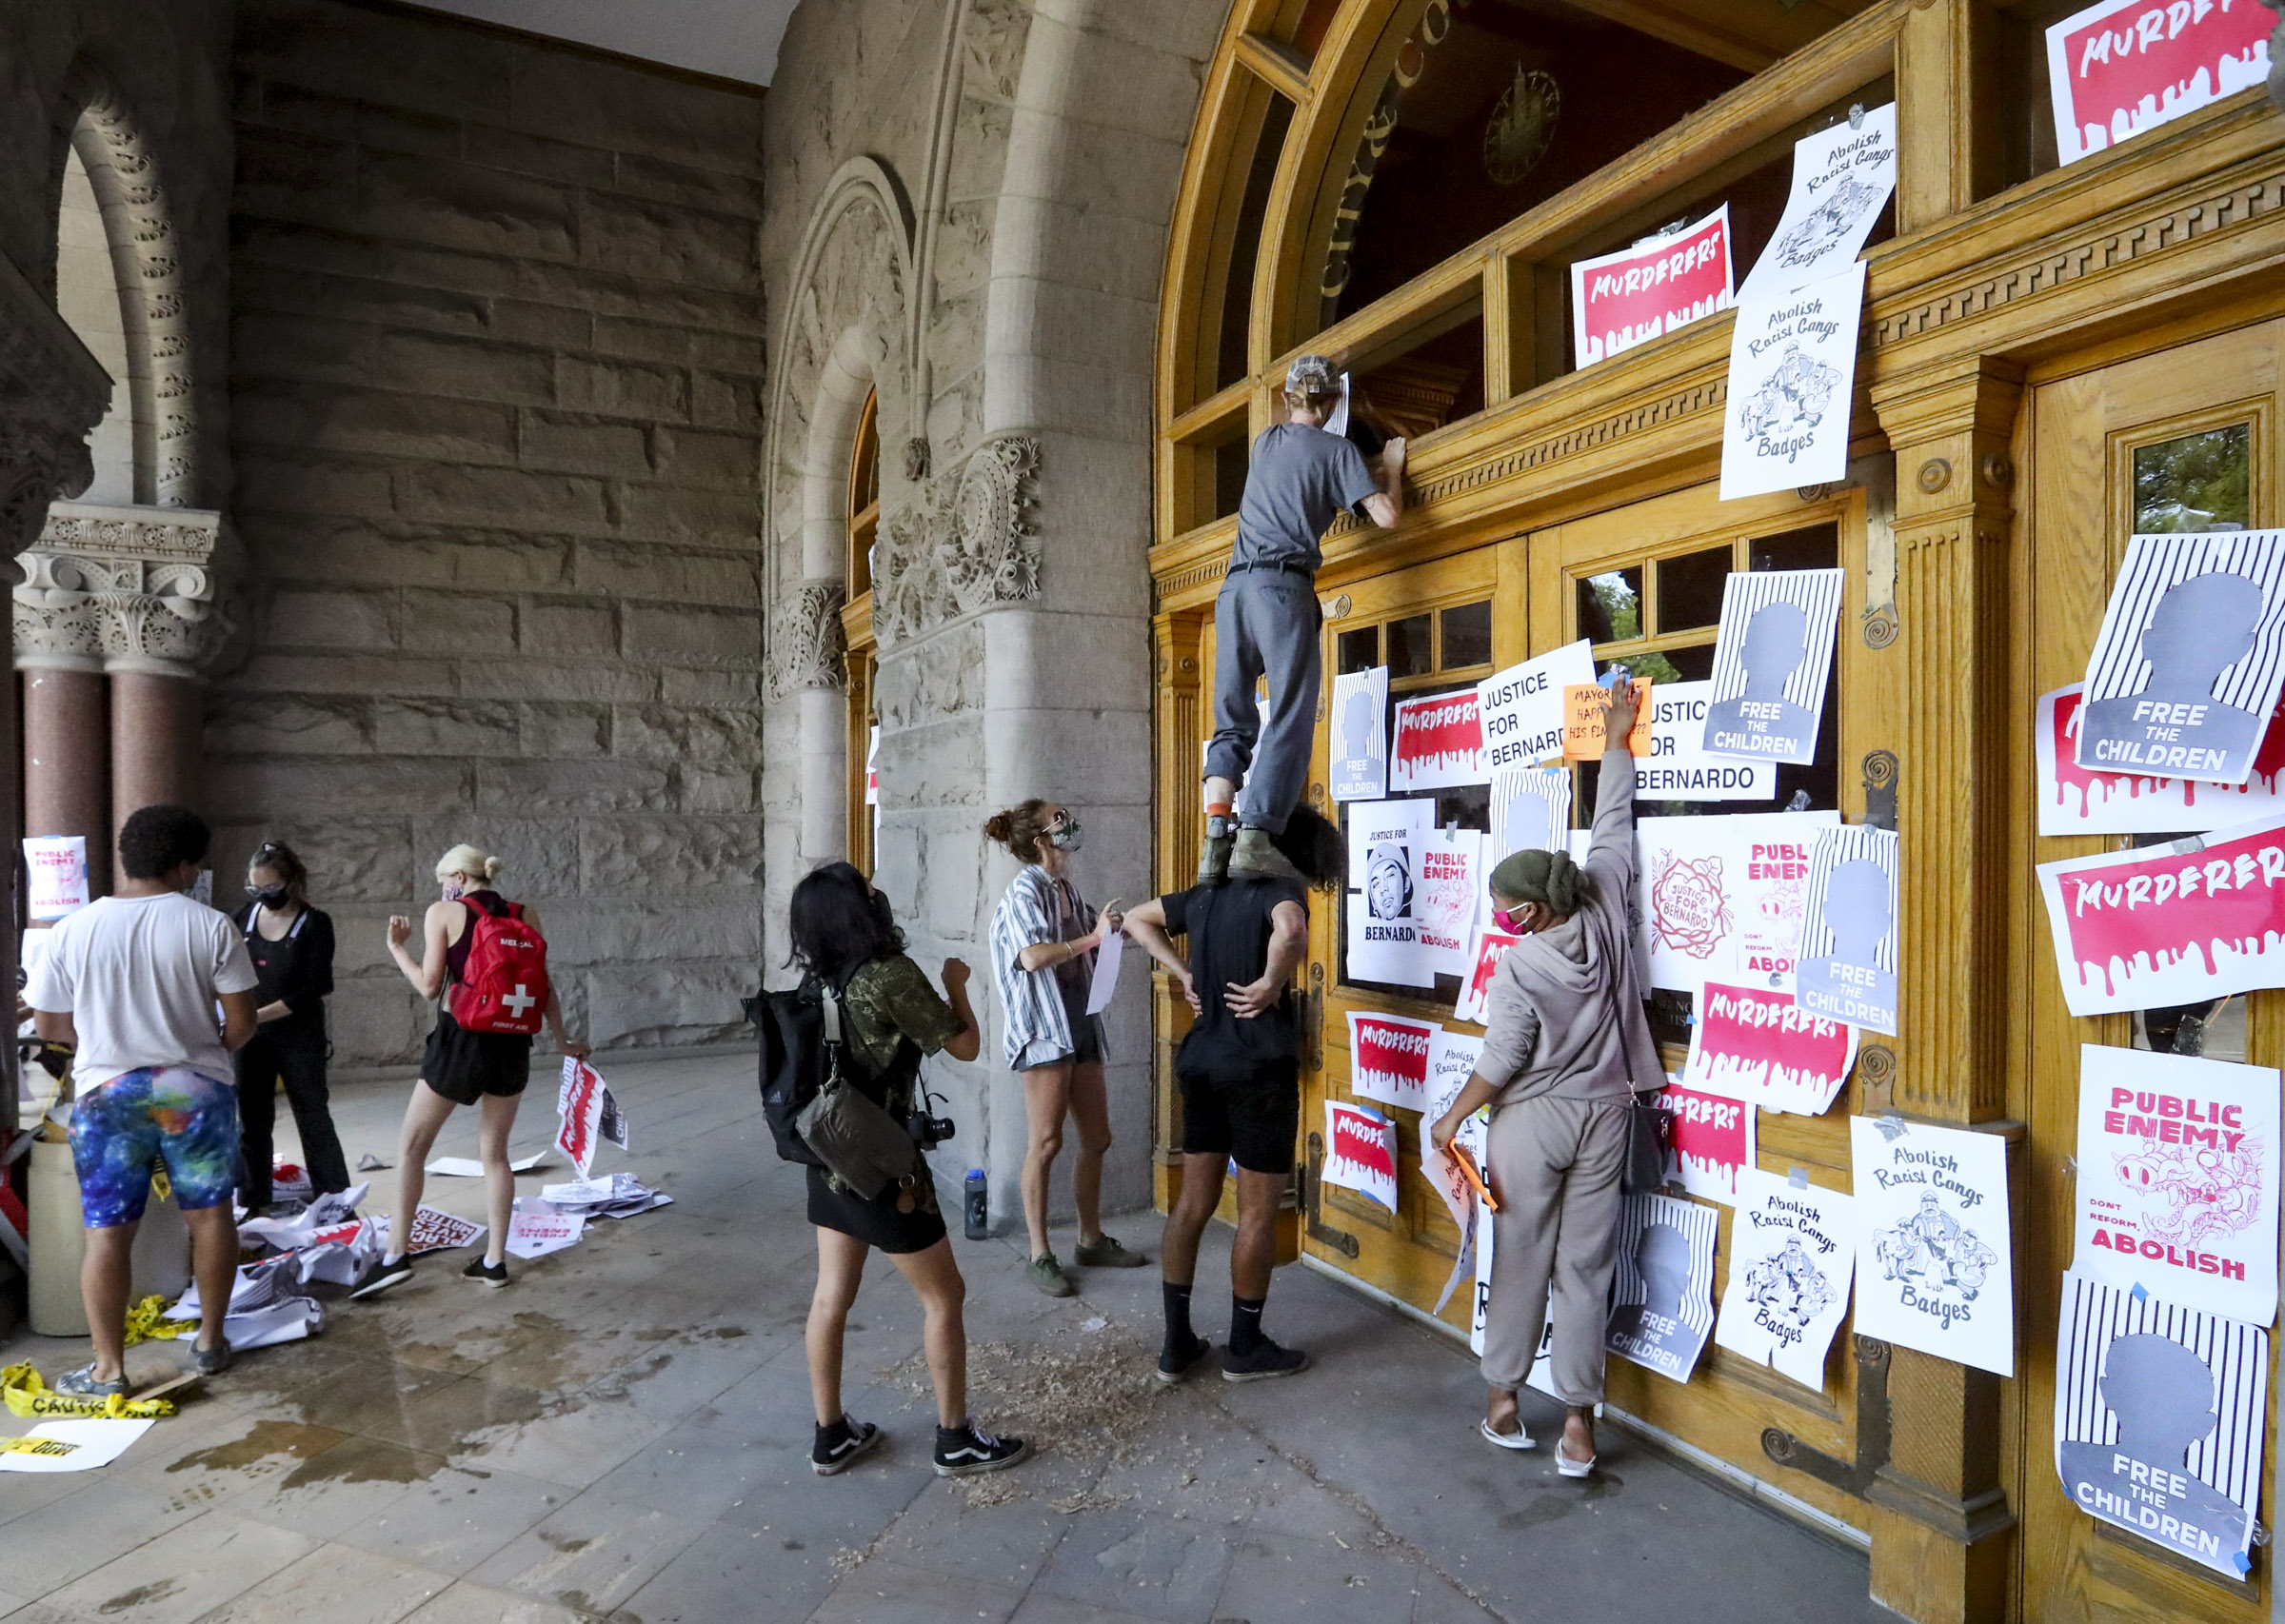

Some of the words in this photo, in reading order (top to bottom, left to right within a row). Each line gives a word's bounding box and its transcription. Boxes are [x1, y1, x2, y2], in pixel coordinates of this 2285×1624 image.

[2079, 0, 2232, 78] MURDE
[1827, 129, 1882, 168] Abolish
[1806, 158, 1851, 194] Racist
[1855, 149, 1895, 170] Gangs
[1320, 159, 1373, 298] CITY
[1590, 229, 1721, 305] MURDERERS
[1779, 239, 1838, 268] Badges
[1767, 297, 1823, 330] Abolish
[1747, 324, 1794, 359] Racist
[1797, 317, 1839, 344] Gangs
[1757, 430, 1815, 465] Badges
[1484, 670, 1549, 711] JUSTICE
[1577, 706, 1603, 722] HAPP
[1739, 701, 1783, 721] FREE
[2132, 700, 2209, 726] FREE
[1487, 712, 1519, 739] FOR
[1569, 725, 1587, 740] HIS
[1746, 720, 1768, 733] THE
[2144, 725, 2182, 743] THE
[1651, 736, 1676, 757] OR
[1714, 731, 1798, 755] CHILDREN
[2095, 738, 2228, 772] CHILDREN
[1346, 759, 1368, 772] FREE
[1352, 772, 1362, 781] THE
[1636, 766, 1754, 790] BERNARDO
[1337, 781, 1379, 795] CHILDREN
[1369, 829, 1393, 842] JUSTICE
[1394, 828, 1407, 839] FOR
[1424, 851, 1468, 867] PUBLIC
[1751, 842, 1809, 862] PUBL
[1422, 866, 1466, 881] ENEMY
[2076, 845, 2285, 919] MURDERER
[1671, 884, 1708, 906] JUSTICE
[1676, 895, 1699, 913] FOR
[1663, 901, 1708, 930] BERNARDO
[1421, 933, 1460, 951] ABOLISH
[1828, 961, 1877, 988] FREE
[1838, 982, 1863, 1000] THE
[1805, 990, 1895, 1028] CHILDREN
[1444, 1048, 1475, 1065] Abolish
[2110, 1086, 2243, 1129] PUBLIC
[1336, 1115, 1386, 1149] MURDER
[2104, 1110, 2246, 1155] ENEMY
[1893, 1146, 1959, 1174] Abolish
[1873, 1167, 1928, 1191] Racist
[1932, 1169, 1985, 1209] Gangs
[1767, 1195, 1821, 1224] Abolish
[2089, 1198, 2122, 1211] DONT
[409, 1231, 463, 1247] BLAC
[1749, 1210, 1794, 1230] Racist
[1798, 1218, 1838, 1255] Gangs
[2091, 1228, 2246, 1282] ABOLISH
[1899, 1284, 1972, 1331] Badges
[1639, 1309, 1677, 1337] FREE
[1644, 1327, 1663, 1343] THE
[1753, 1307, 1803, 1350] Badges
[1612, 1330, 1683, 1373] CHILDREN
[2113, 1453, 2188, 1500] FREE
[2129, 1483, 2167, 1510] THE
[2076, 1481, 2221, 1559] CHILDREN
